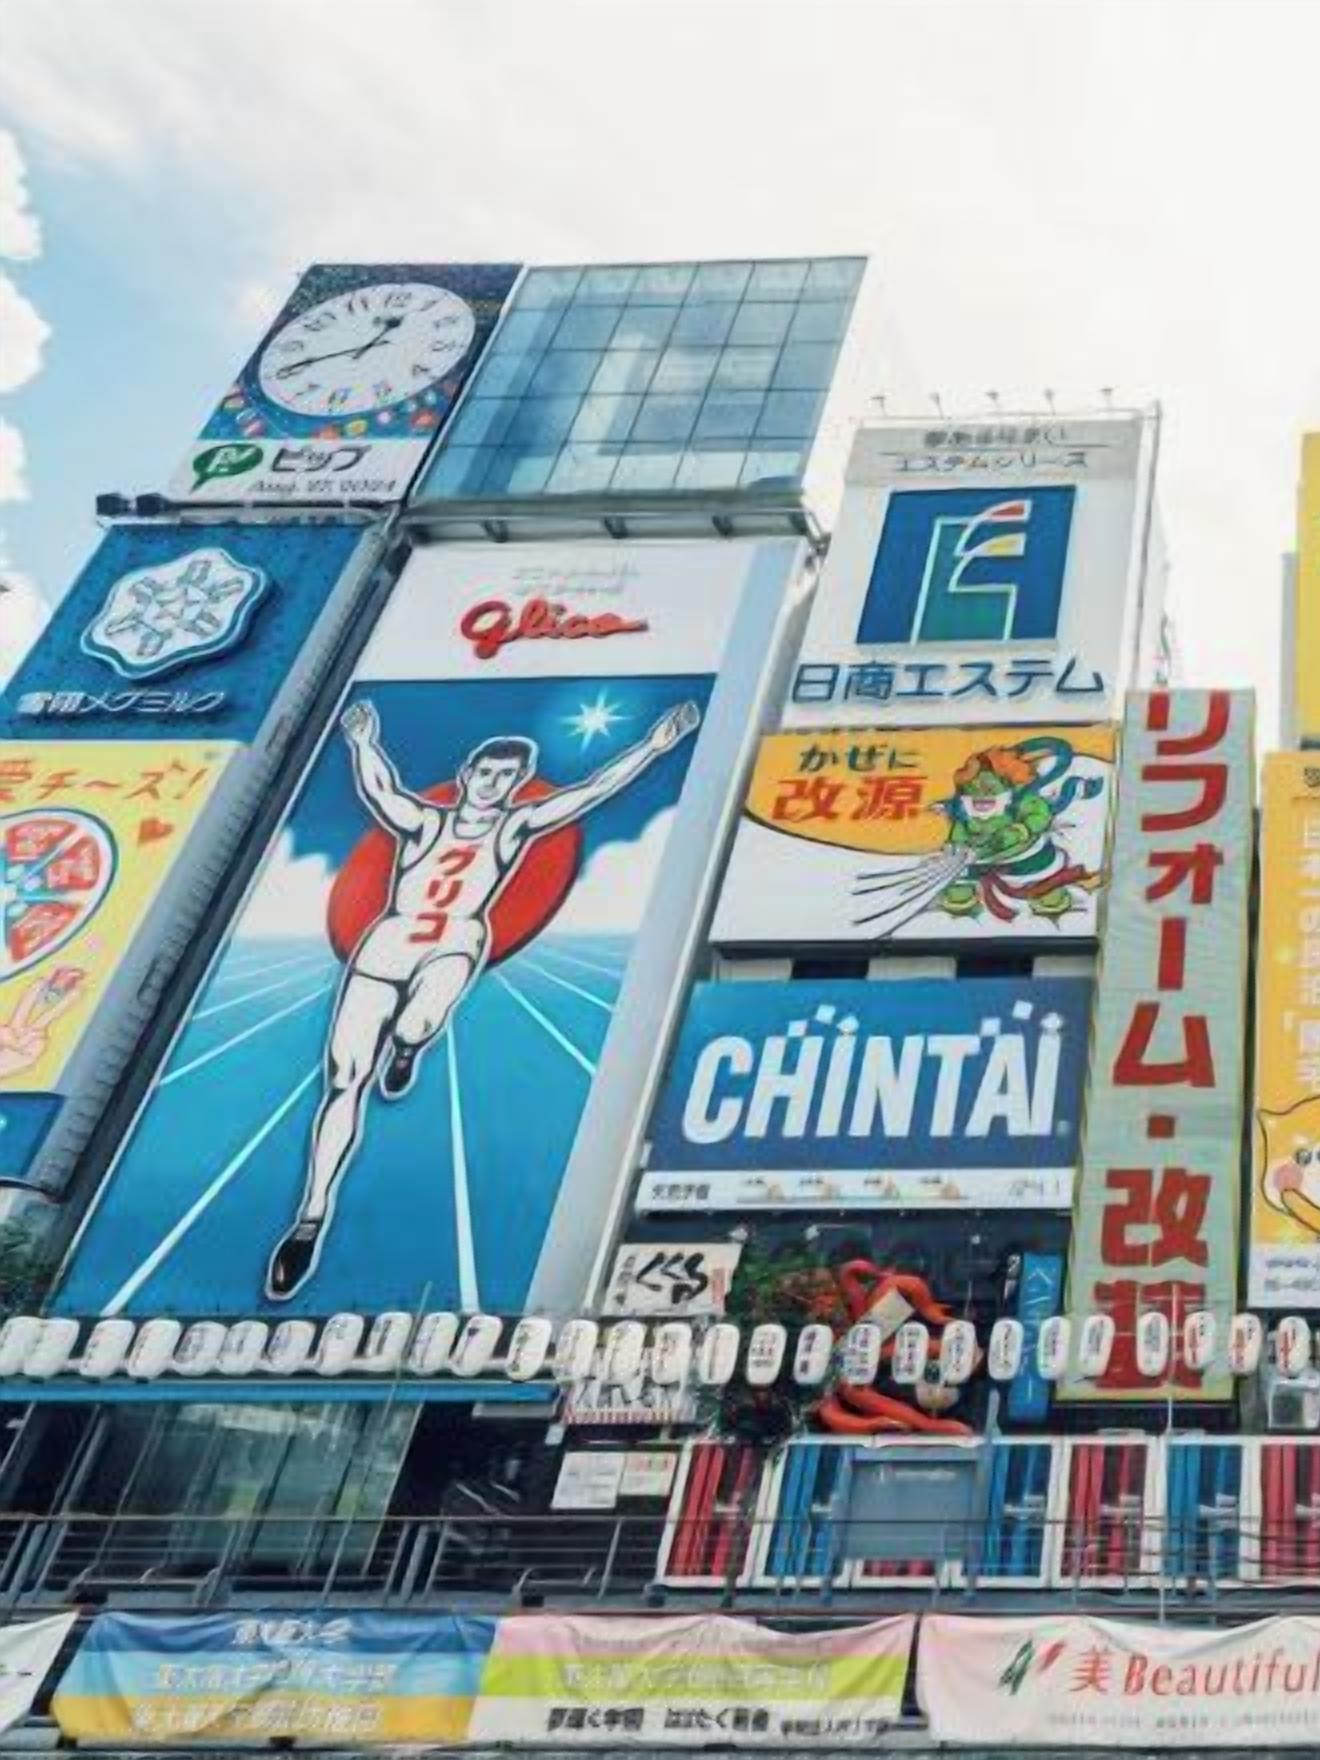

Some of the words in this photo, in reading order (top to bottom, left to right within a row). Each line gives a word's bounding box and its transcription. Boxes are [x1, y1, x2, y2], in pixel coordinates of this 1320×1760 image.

[792, 659, 1106, 704] 日商エステム
[798, 743, 922, 773] かぜに
[771, 774, 929, 822] 改源
[408, 844, 483, 943] グリコ
[1069, 1646, 1109, 1693] 美
